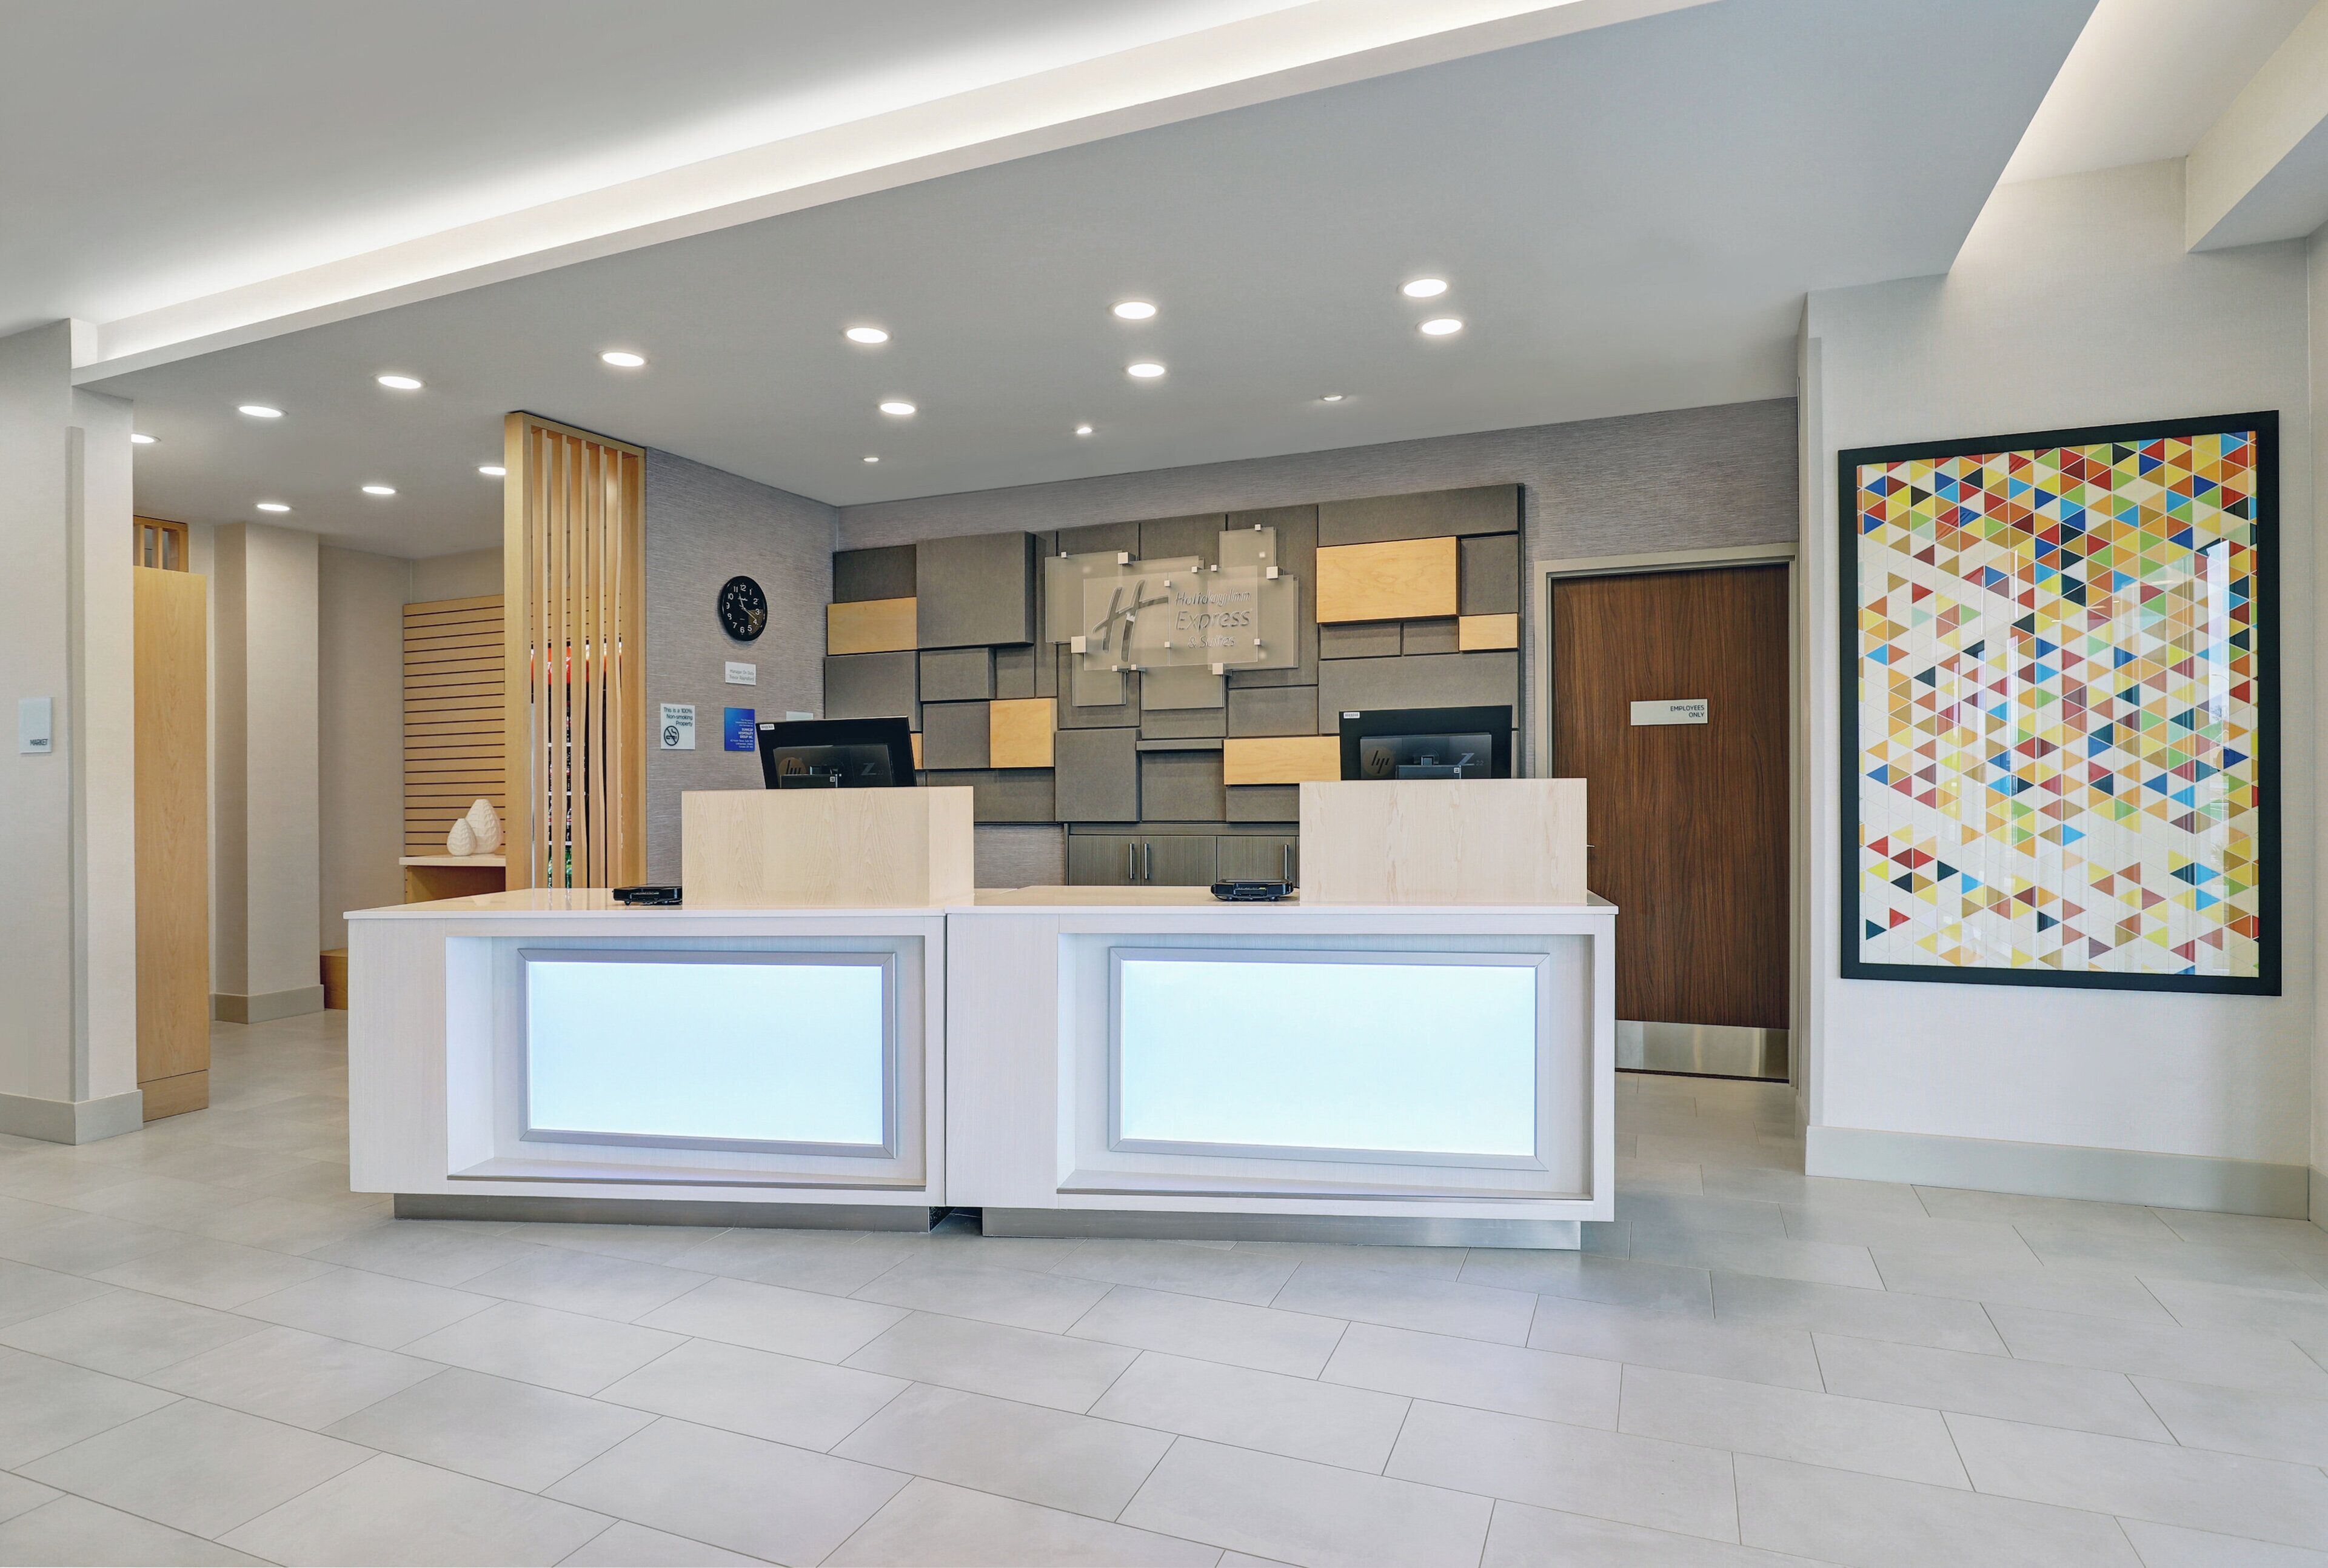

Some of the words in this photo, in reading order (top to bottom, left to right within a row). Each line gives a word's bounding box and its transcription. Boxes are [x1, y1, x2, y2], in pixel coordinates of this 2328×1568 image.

[1176, 590, 1227, 607] Holiday
[1228, 587, 1251, 602] Inn
[1175, 610, 1251, 632] Express
[1188, 636, 1196, 649] &
[1200, 635, 1236, 648] Suites
[1371, 750, 1390, 774] hp
